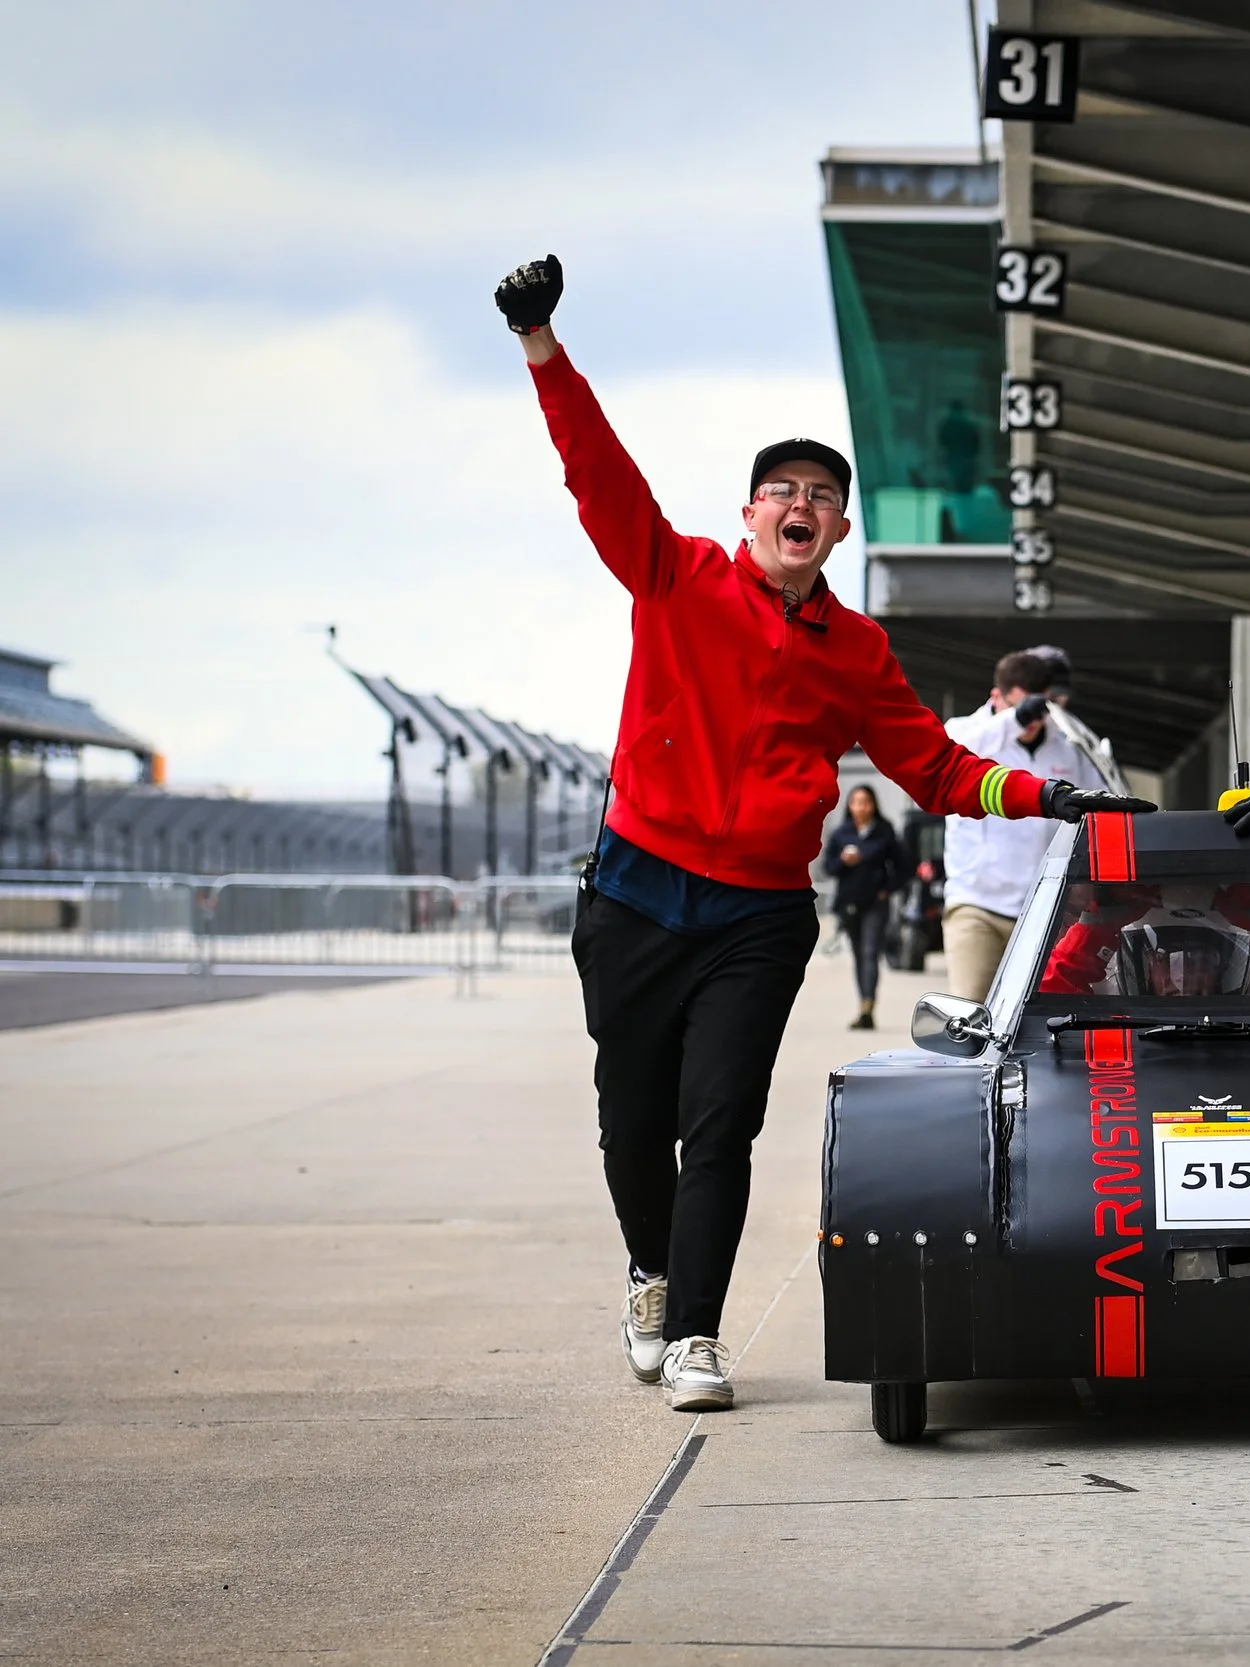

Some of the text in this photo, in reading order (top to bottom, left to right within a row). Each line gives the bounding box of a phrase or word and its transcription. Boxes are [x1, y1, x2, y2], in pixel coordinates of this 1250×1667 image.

[998, 38, 1064, 107] 31
[996, 250, 1062, 307] 32
[1009, 385, 1058, 428] 33
[1010, 470, 1053, 506] 34
[1013, 532, 1053, 563] 35
[1088, 1060, 1144, 1293] ARMSTRONG
